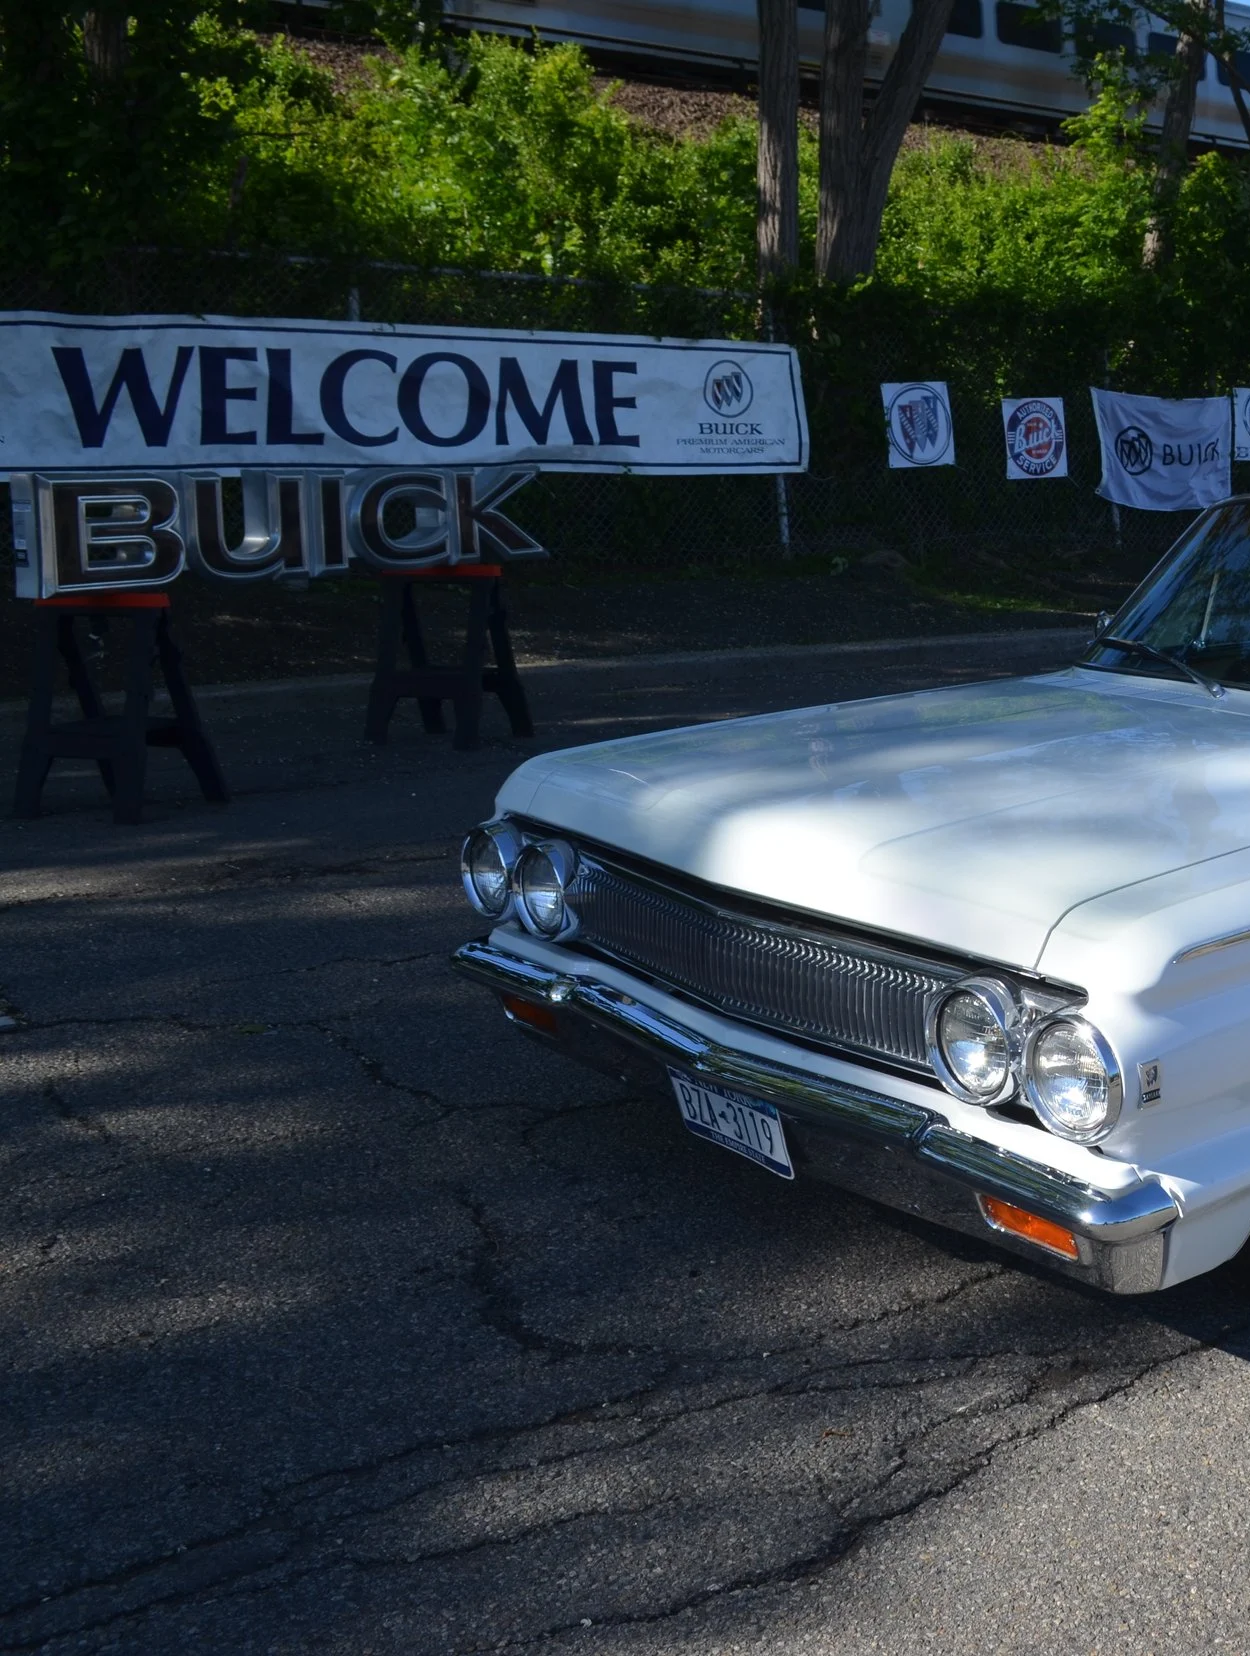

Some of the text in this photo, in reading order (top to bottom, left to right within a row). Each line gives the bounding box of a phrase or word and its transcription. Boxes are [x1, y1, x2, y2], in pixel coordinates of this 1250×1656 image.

[52, 345, 640, 448] WELCOME
[1016, 402, 1054, 420] AUTHORIZED
[698, 422, 763, 435] BUICK
[1013, 418, 1063, 454] Buick
[676, 438, 785, 446] PREMIUM AMERICAN
[699, 447, 765, 455] MOTORCARS
[1016, 454, 1058, 474] SERVICE
[38, 466, 549, 598] BUICK
[679, 1083, 774, 1156] BZA 3119
